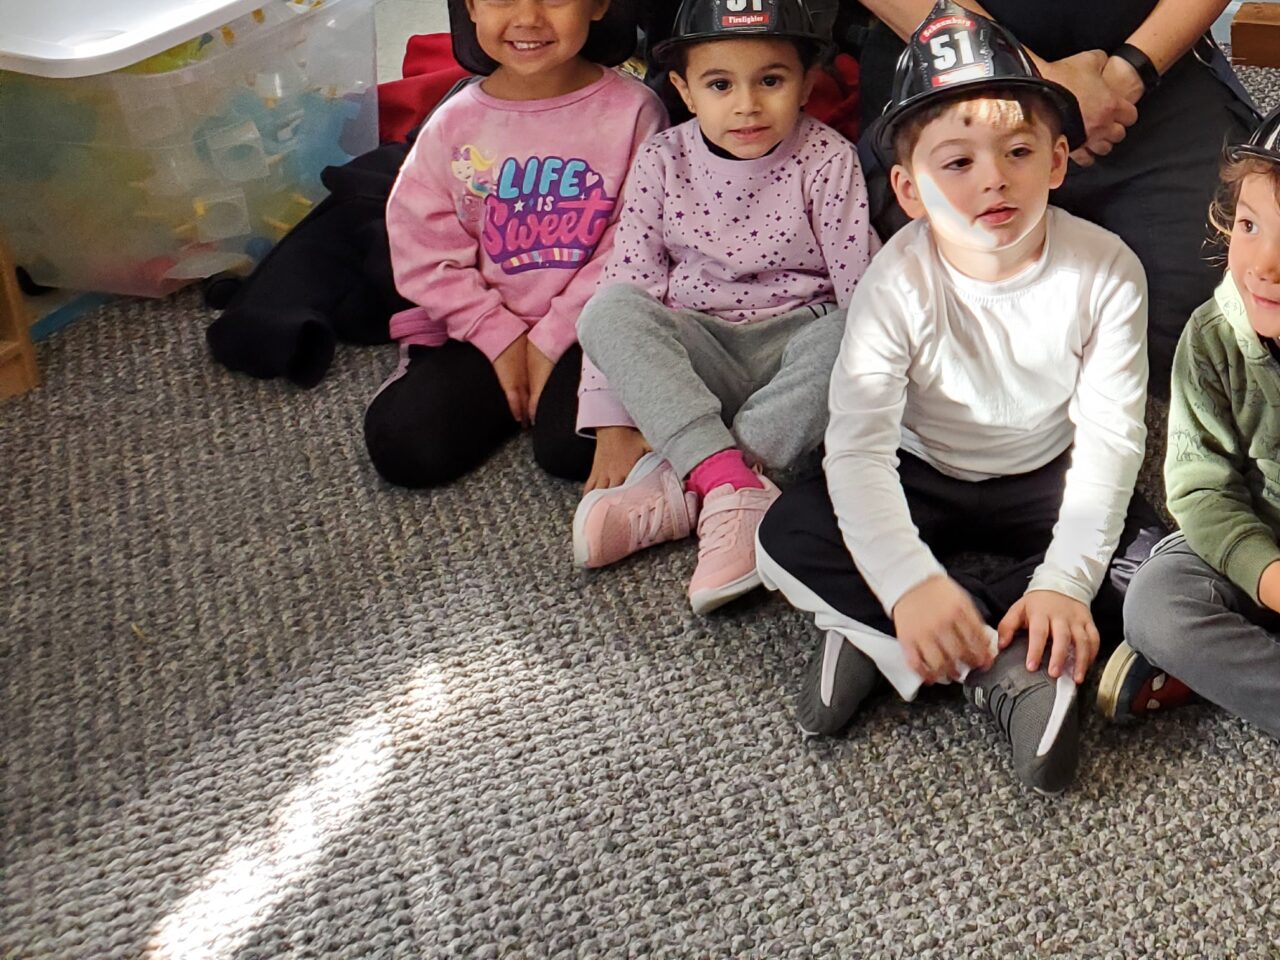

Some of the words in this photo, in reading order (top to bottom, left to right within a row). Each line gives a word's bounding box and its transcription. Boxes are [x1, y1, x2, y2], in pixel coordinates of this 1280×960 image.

[930, 30, 975, 71] 51
[498, 157, 587, 199] LIFE
[483, 187, 615, 256] Sweet
[536, 196, 555, 212] IS
